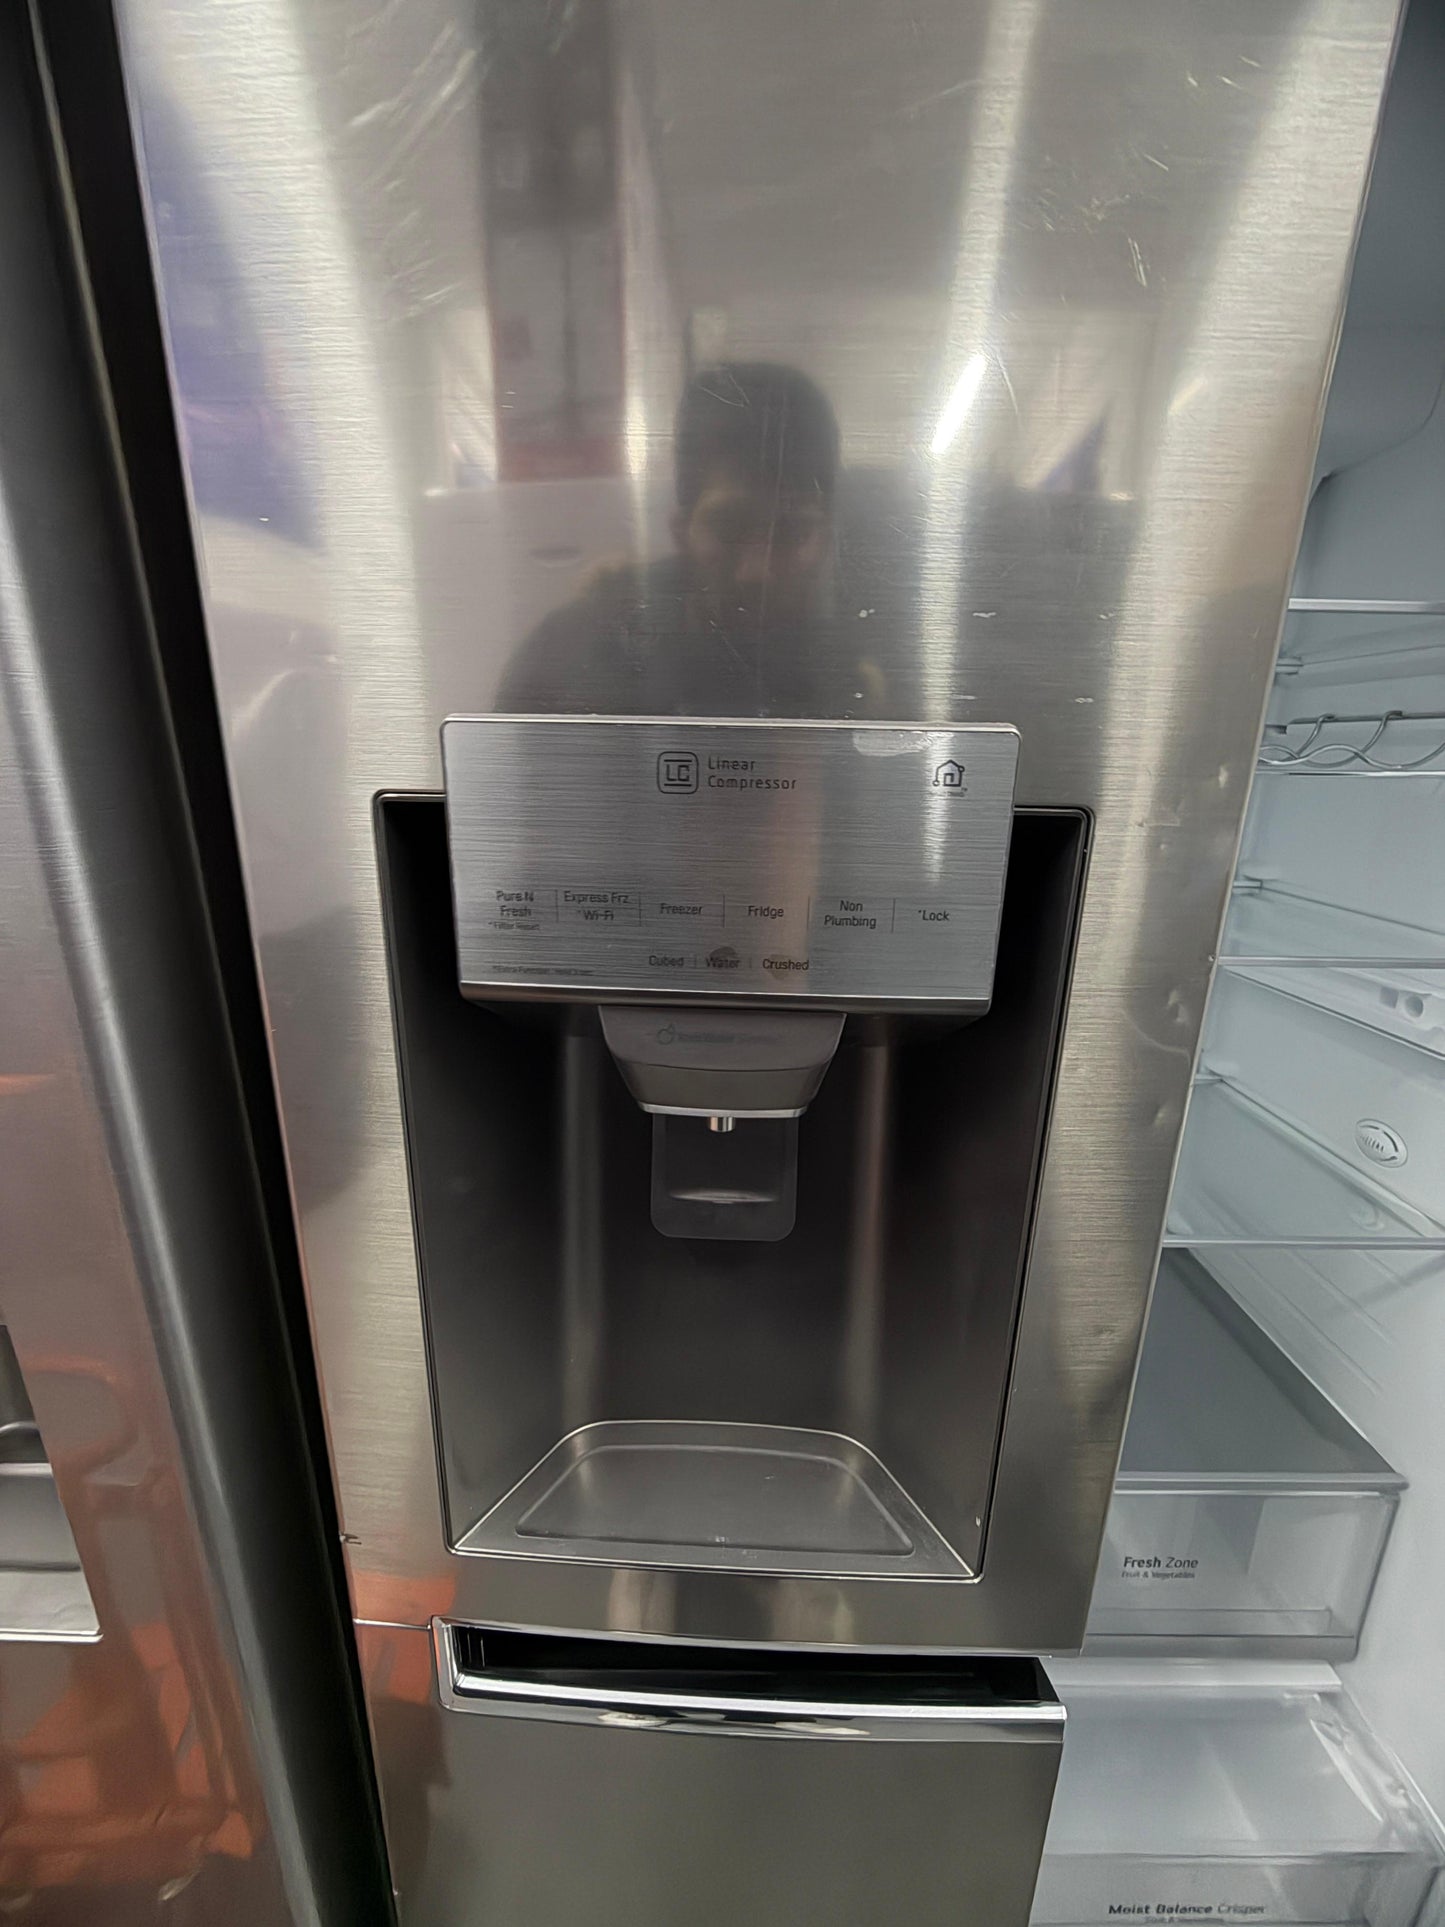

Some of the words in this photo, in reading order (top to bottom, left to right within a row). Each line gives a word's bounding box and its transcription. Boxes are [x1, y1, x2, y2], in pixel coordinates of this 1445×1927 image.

[708, 756, 756, 771] Linear
[708, 775, 797, 791] Compressor
[563, 890, 608, 904] Express
[500, 905, 532, 917] Fresh
[660, 903, 703, 915] Freezer
[839, 900, 863, 912] Non
[747, 906, 785, 919] Fridge
[824, 915, 877, 930] Plumbing
[648, 955, 685, 967] Cubed
[706, 957, 741, 969] Water
[762, 959, 810, 971] Crushed
[1123, 1556, 1161, 1568] Fresh
[1165, 1556, 1199, 1569] Zone
[1108, 1904, 1150, 1915] Moist
[1156, 1903, 1213, 1914] Balance
